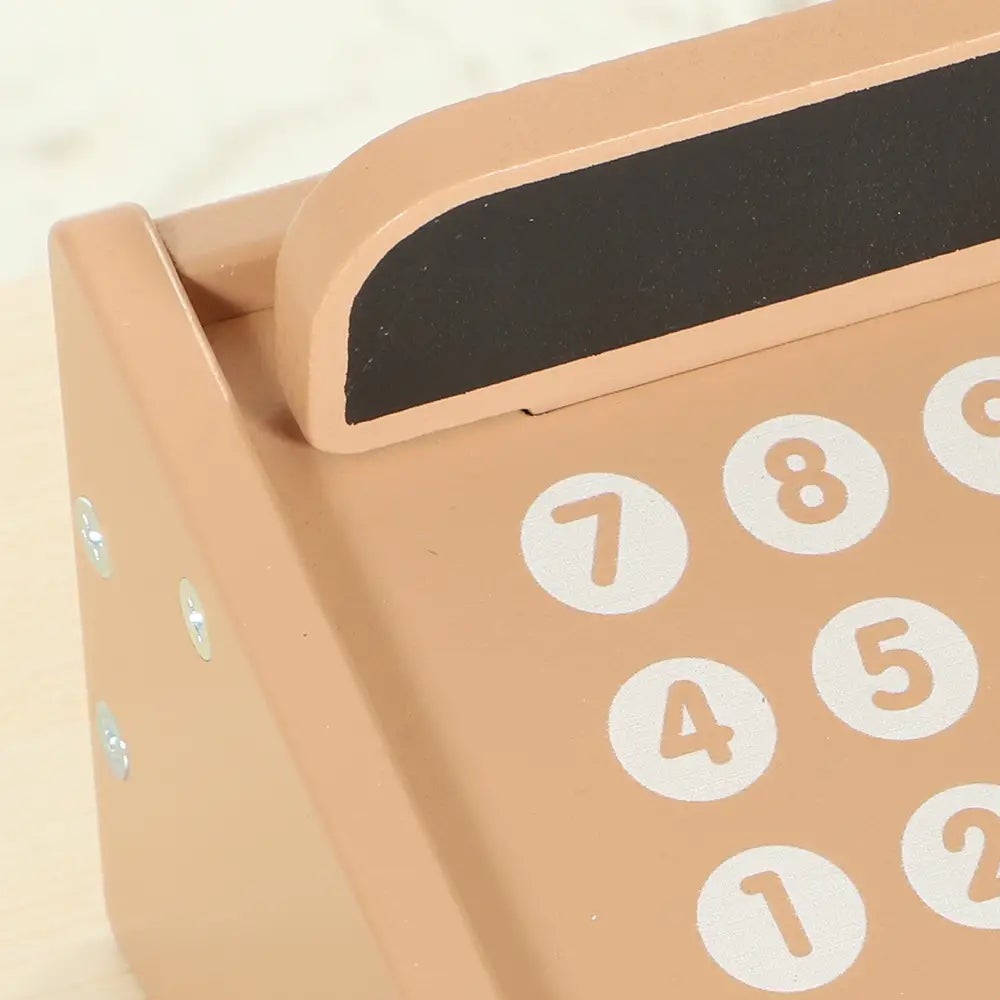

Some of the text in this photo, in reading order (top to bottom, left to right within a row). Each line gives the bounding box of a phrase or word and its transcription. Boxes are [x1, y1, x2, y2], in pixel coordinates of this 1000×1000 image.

[550, 492, 623, 588] 7
[764, 437, 849, 526] 8
[659, 679, 735, 766] 4
[854, 617, 934, 712] 5
[739, 870, 813, 958] 1
